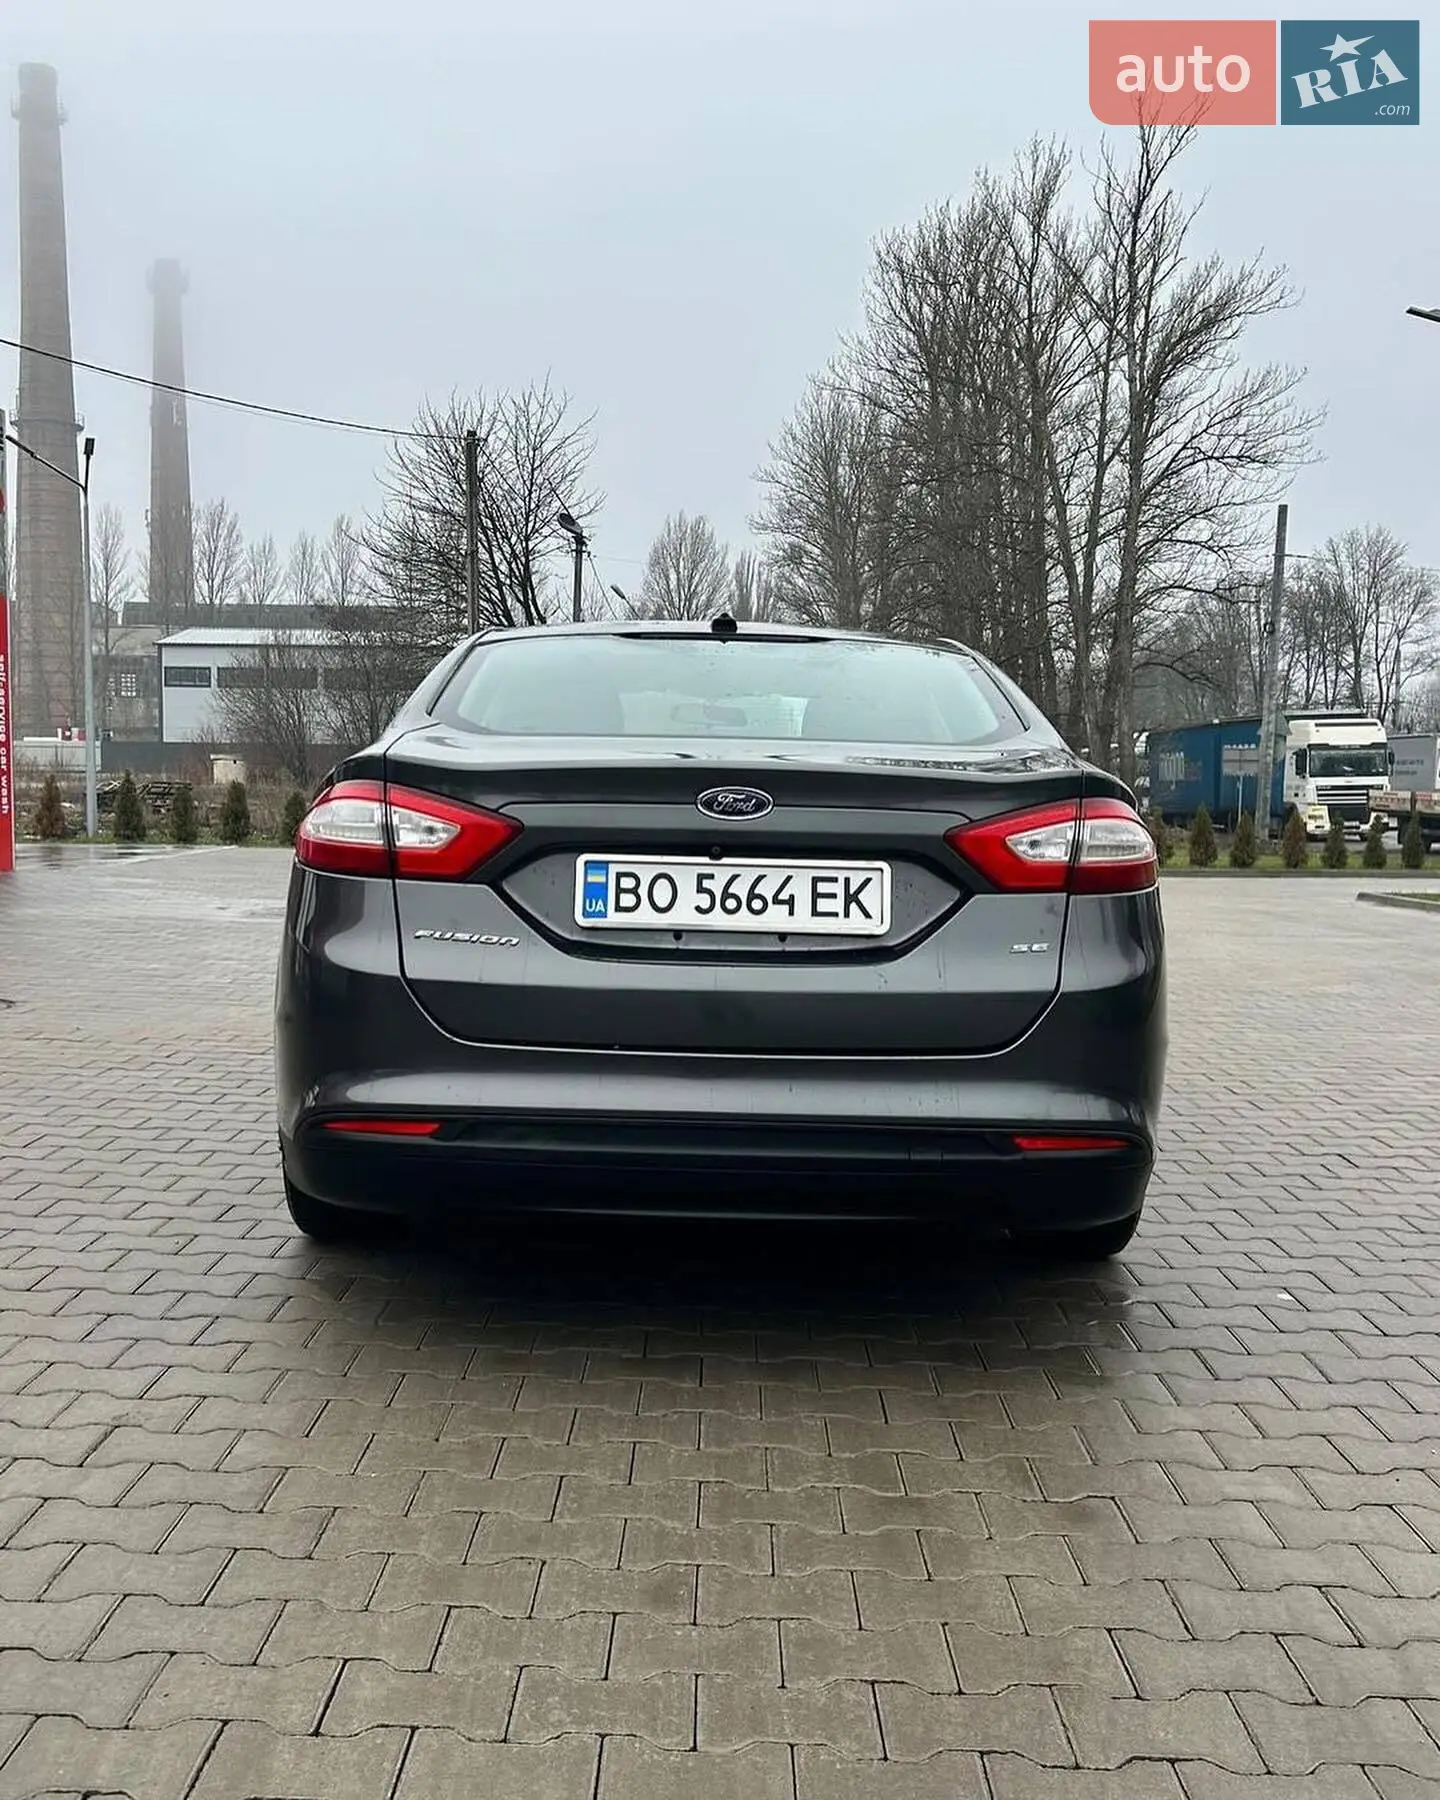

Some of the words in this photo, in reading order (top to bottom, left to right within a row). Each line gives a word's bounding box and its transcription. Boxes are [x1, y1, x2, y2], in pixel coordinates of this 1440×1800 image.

[1, 775, 9, 815] wash
[713, 793, 756, 812] Ford
[613, 871, 678, 914] BO
[694, 873, 796, 916] 5664
[811, 876, 874, 920] EK
[586, 901, 606, 914] UA
[414, 929, 520, 947] FUSION
